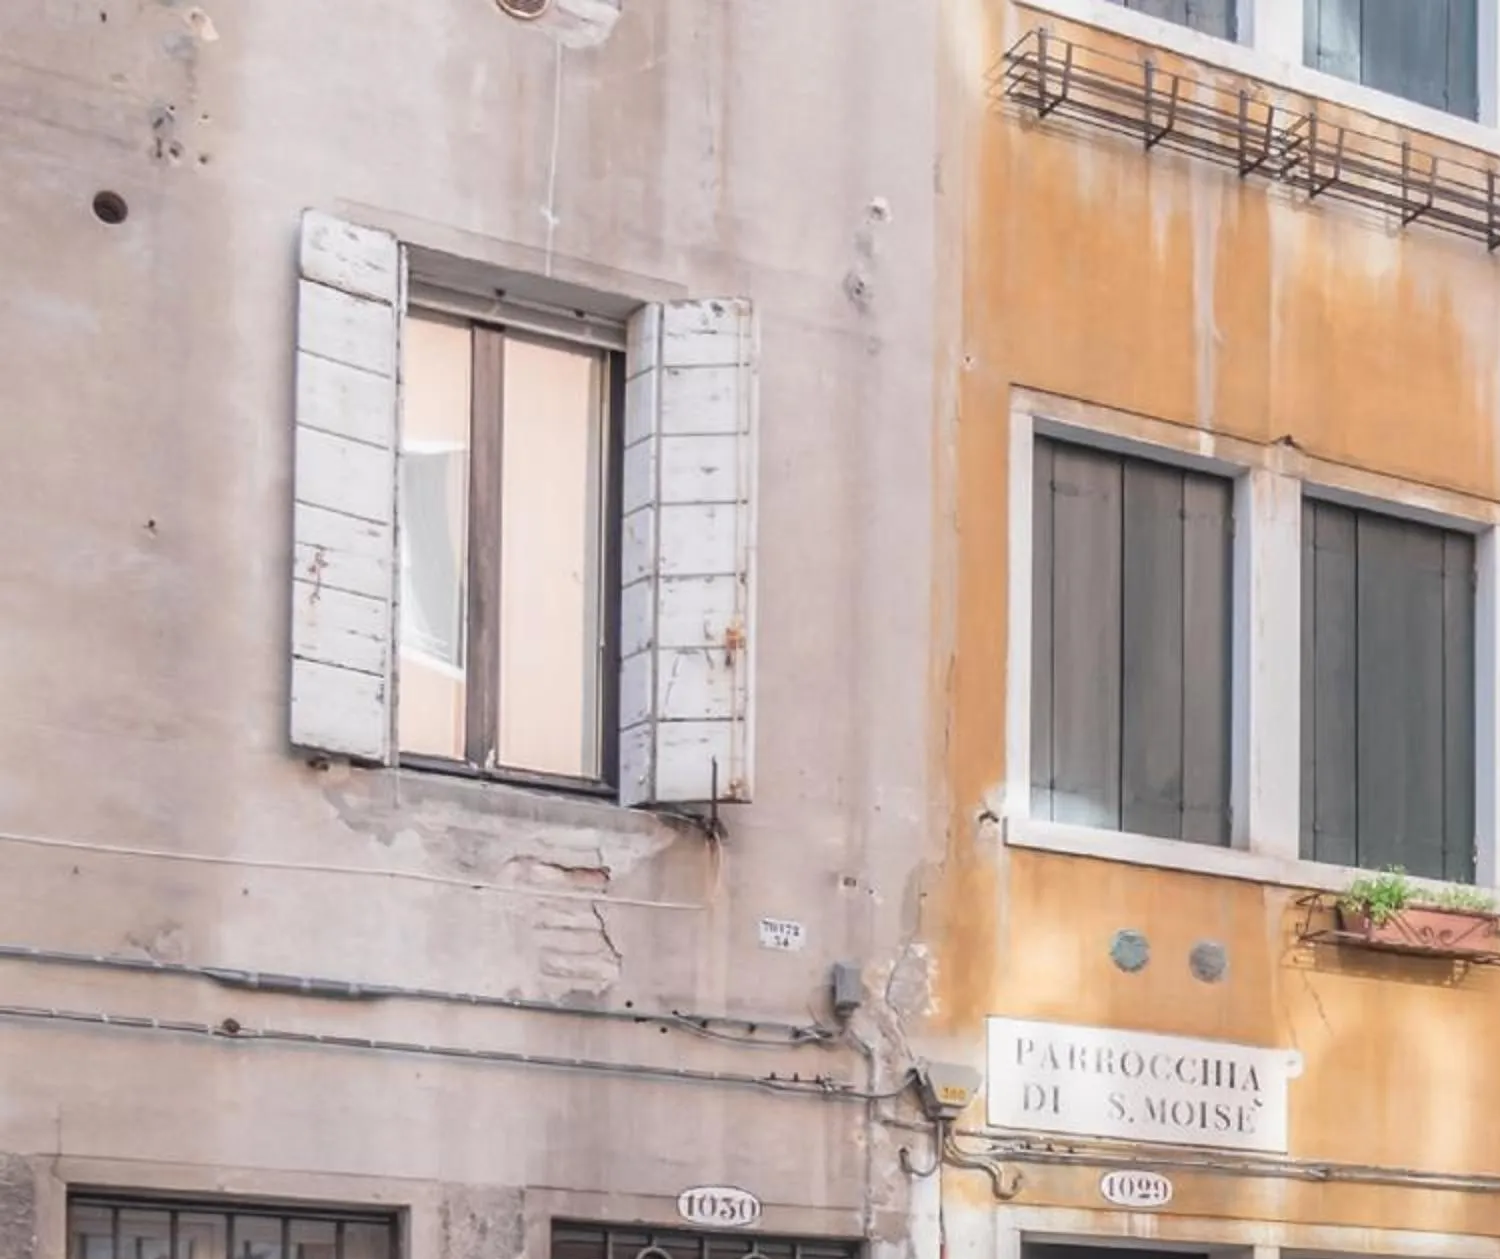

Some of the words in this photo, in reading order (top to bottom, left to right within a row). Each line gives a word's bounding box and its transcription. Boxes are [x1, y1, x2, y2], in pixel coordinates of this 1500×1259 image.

[1016, 1037, 1262, 1093] PARROCCHIA
[1023, 1084, 1060, 1114] DI
[1107, 1176, 1169, 1199] 1029
[686, 1193, 757, 1220] 1030
